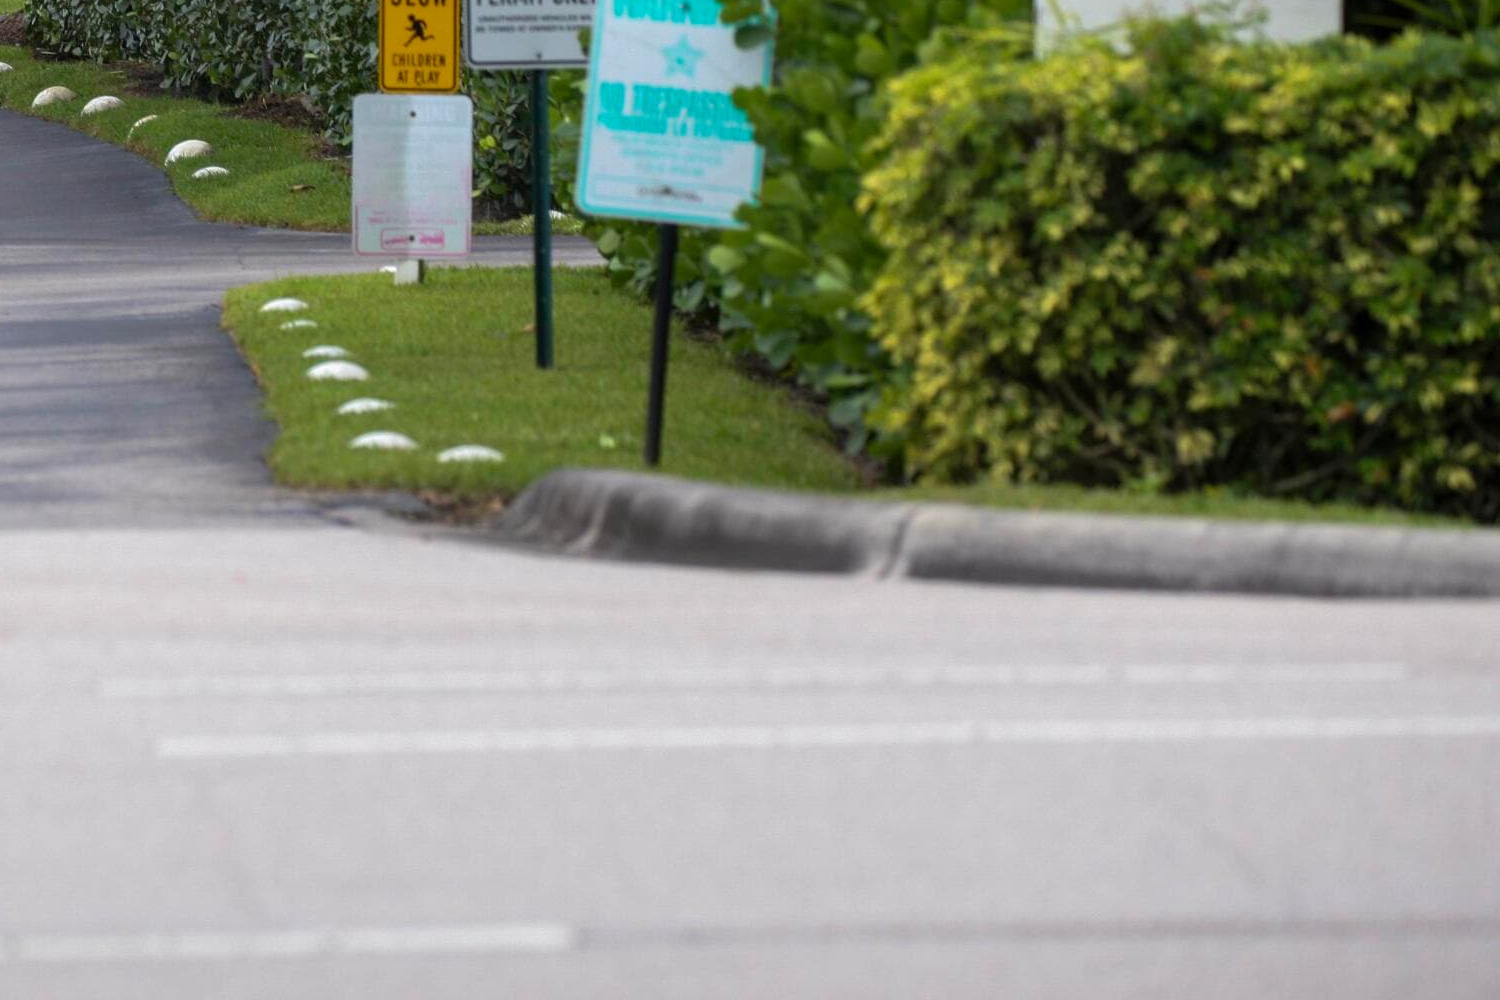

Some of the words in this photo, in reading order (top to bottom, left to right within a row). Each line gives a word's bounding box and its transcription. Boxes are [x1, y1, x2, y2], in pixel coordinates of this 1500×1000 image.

[391, 52, 447, 68] CHILDREN
[396, 69, 409, 84] AT
[413, 69, 441, 85] PLAY
